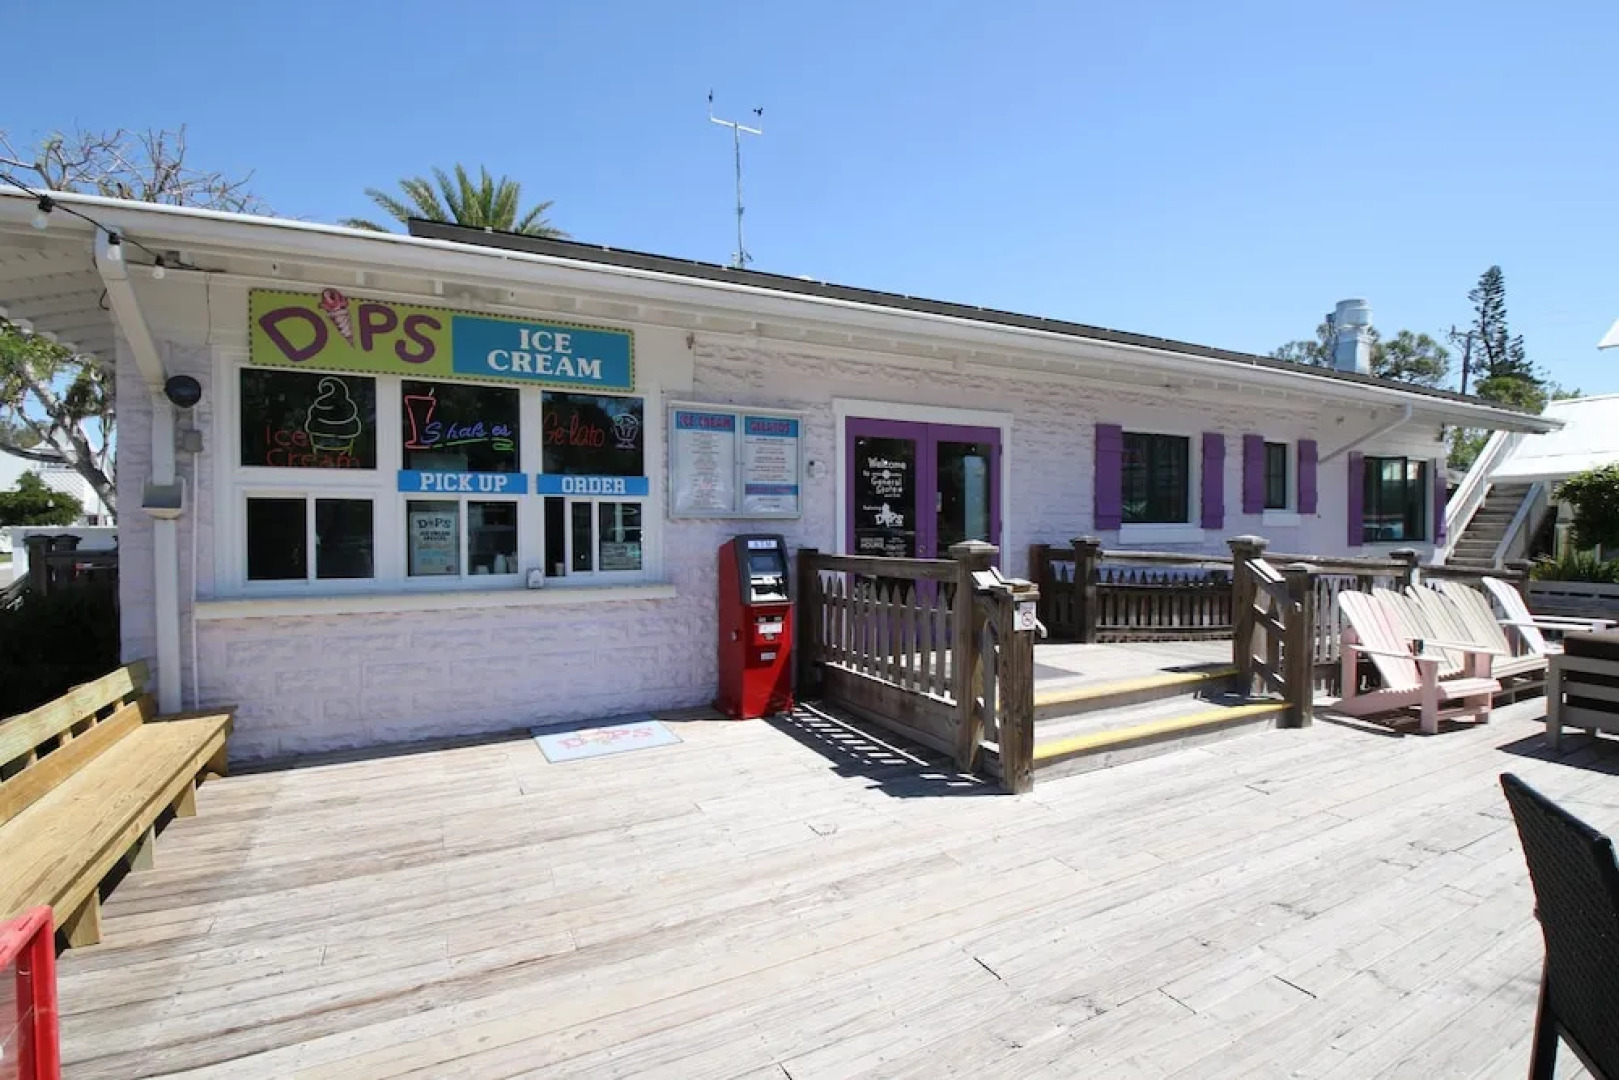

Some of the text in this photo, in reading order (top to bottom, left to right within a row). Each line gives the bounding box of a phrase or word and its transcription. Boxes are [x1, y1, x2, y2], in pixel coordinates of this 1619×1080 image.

[258, 288, 442, 363] DIPS
[518, 328, 573, 354] ICE
[486, 349, 603, 380] CREAM
[265, 422, 309, 447] Ice
[421, 421, 513, 443] Shakes
[543, 411, 605, 448] Gelato
[266, 448, 363, 467] Cream
[868, 457, 906, 469] Welcome
[420, 472, 508, 493] PICK UP
[561, 477, 626, 495] ORDER
